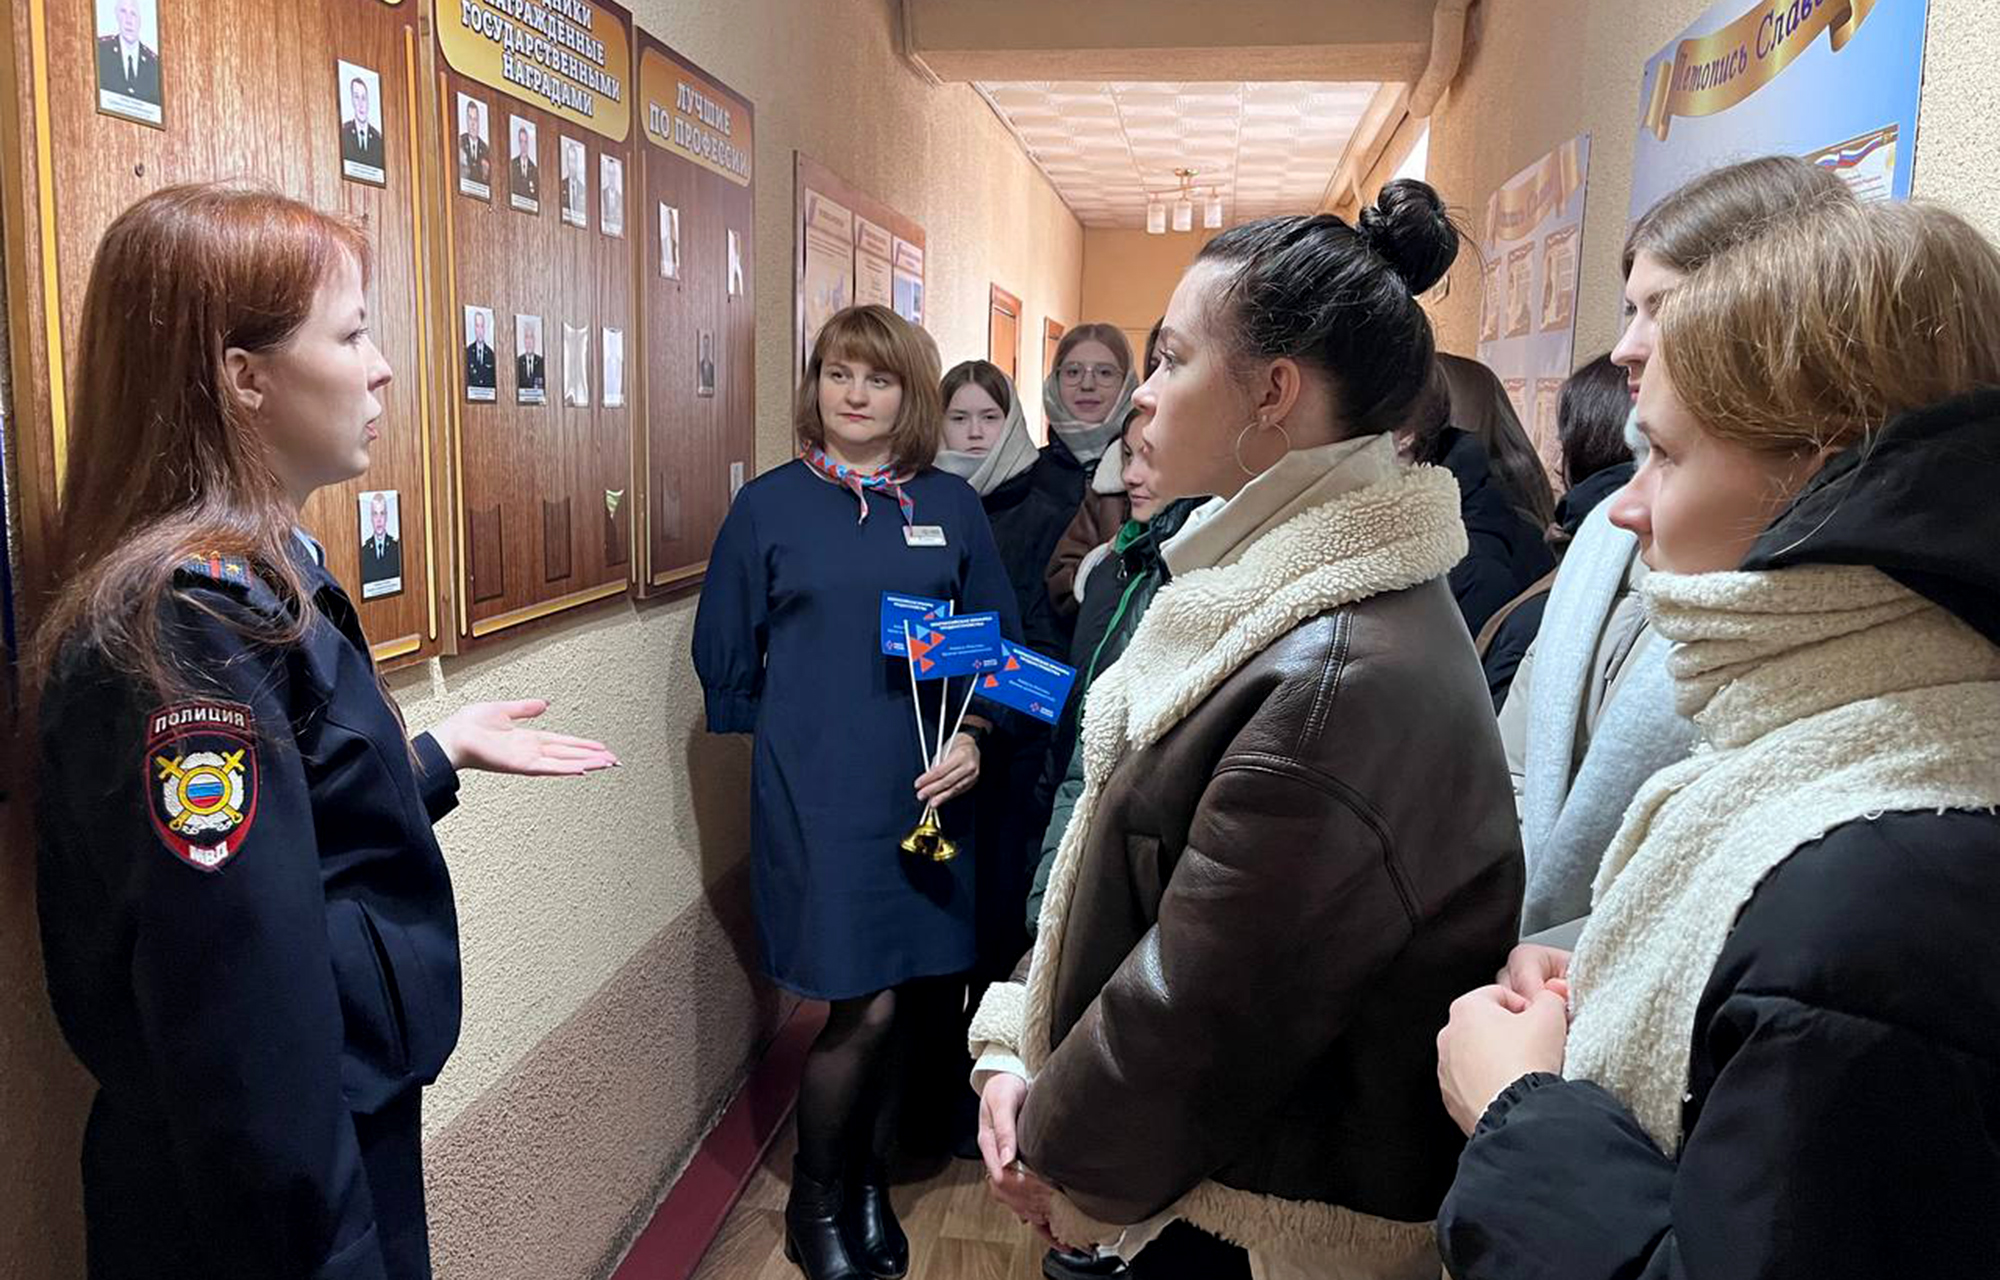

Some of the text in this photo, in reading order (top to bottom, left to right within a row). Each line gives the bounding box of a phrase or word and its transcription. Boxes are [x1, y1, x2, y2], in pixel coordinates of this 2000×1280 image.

[461, 1, 620, 102] ГОСУДАРСТВЕННЫМИ
[502, 52, 594, 118] НАГРАДАМИ
[676, 80, 731, 138] ЛУЧШИЕ
[648, 101, 751, 180] ПО ПРОФЕССИИ
[154, 707, 246, 734] ПОЛИЦИЯ
